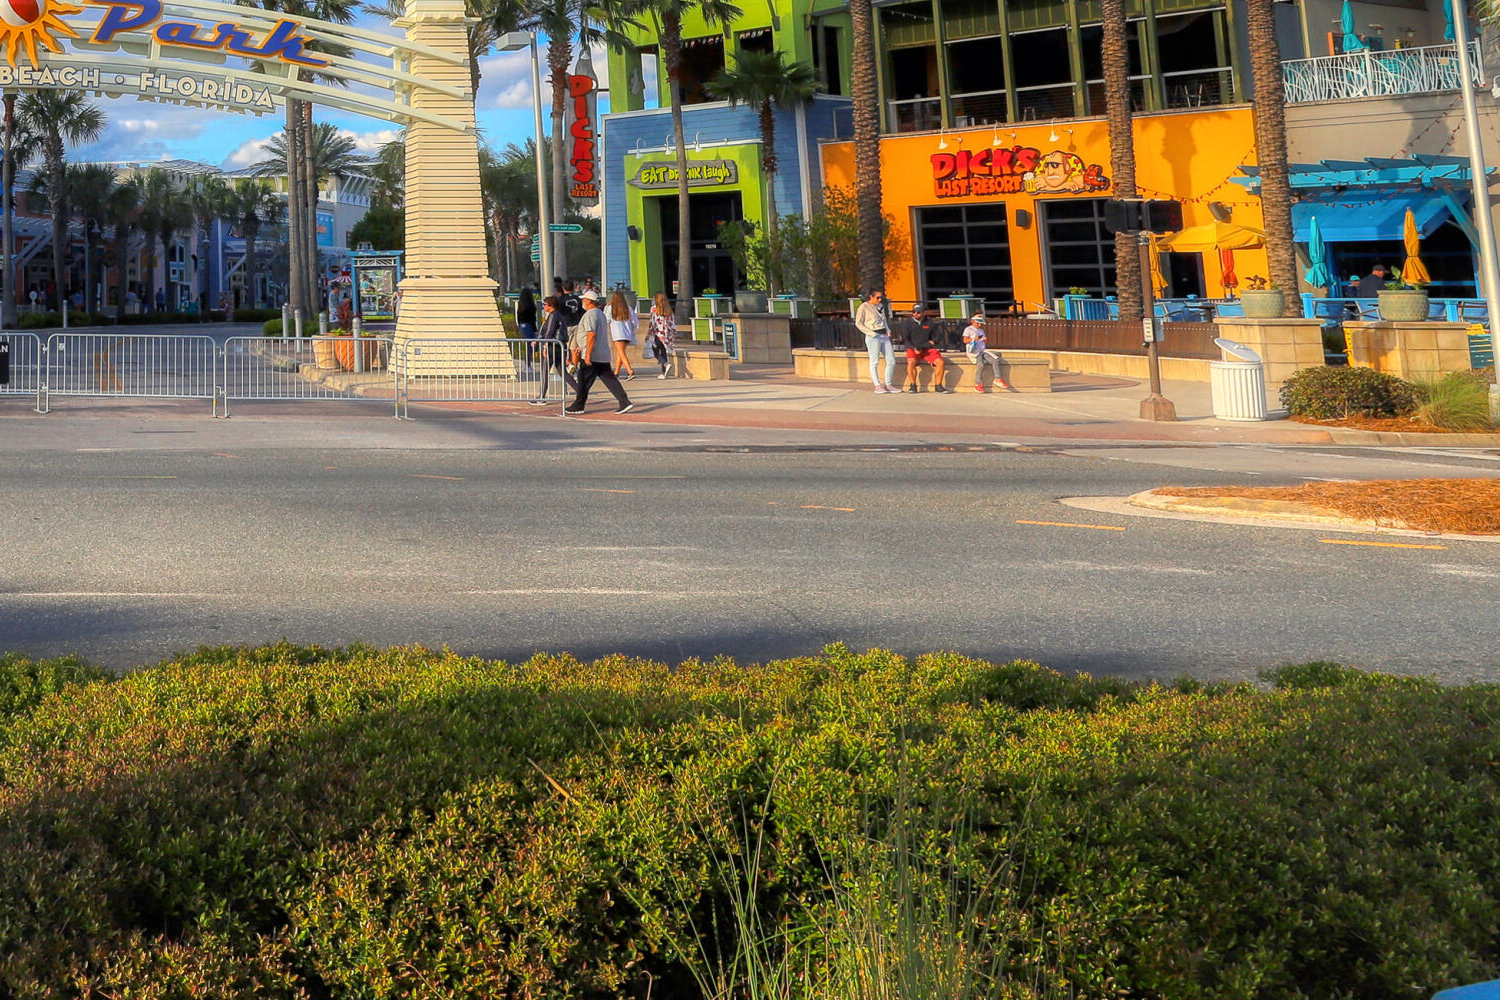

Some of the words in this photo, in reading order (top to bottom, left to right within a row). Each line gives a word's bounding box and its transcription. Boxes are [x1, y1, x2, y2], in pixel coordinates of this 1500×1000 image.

[139, 72, 274, 109] FLORIDA
[568, 74, 594, 182] DICK'S
[641, 166, 668, 184] EAT
[702, 163, 730, 184] laugh
[931, 145, 1041, 180] DICK'S
[571, 189, 598, 198] RESORT
[934, 178, 971, 198] LAST
[971, 174, 1025, 196] RESORT
